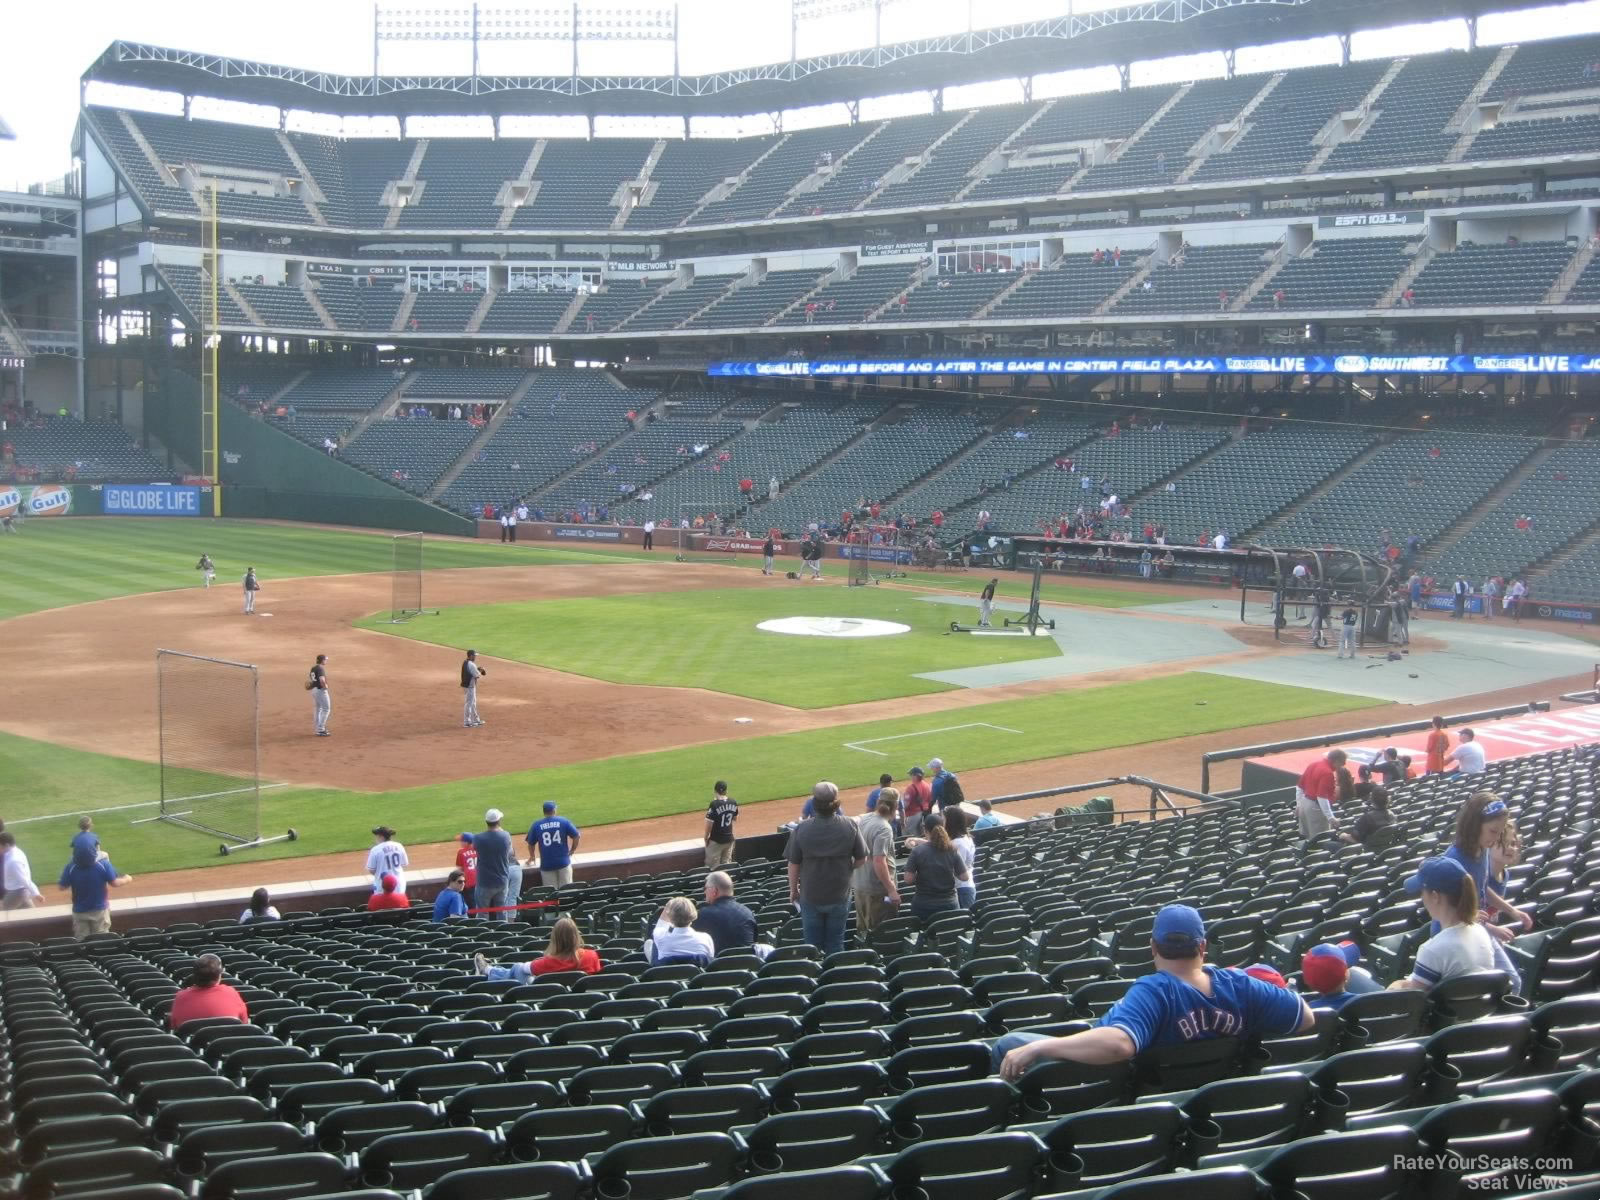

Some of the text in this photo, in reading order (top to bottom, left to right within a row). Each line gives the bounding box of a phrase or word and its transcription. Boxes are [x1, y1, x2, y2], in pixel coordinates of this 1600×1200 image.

[1335, 215, 1366, 226] ESPN
[618, 262, 667, 270] MLB NETWORK
[0, 358, 25, 368] FICE
[815, 363, 841, 373] JOIN
[843, 363, 857, 373] US
[860, 363, 904, 372] BEFORE
[907, 362, 932, 372] AND
[936, 362, 976, 372] AFTER
[980, 362, 1005, 371] THE
[1008, 361, 1044, 371] GAME
[1048, 361, 1061, 371] IN
[1064, 361, 1117, 371] CENTER
[1122, 361, 1160, 371] FIELD
[1164, 360, 1214, 370] PLAZA
[1228, 360, 1268, 369] RANGERS
[1271, 357, 1305, 371] LIVE
[1369, 357, 1449, 370] SOUTHWEST
[1477, 359, 1524, 369] RANGERS
[1528, 356, 1569, 371] LIVE
[0, 493, 18, 507] ulf
[32, 492, 67, 509] Gulf
[121, 490, 195, 510] GLOBE LIFE
[1555, 609, 1592, 619] mazda
[721, 813, 733, 827] 13
[542, 829, 561, 846] 84
[385, 852, 400, 869] 10
